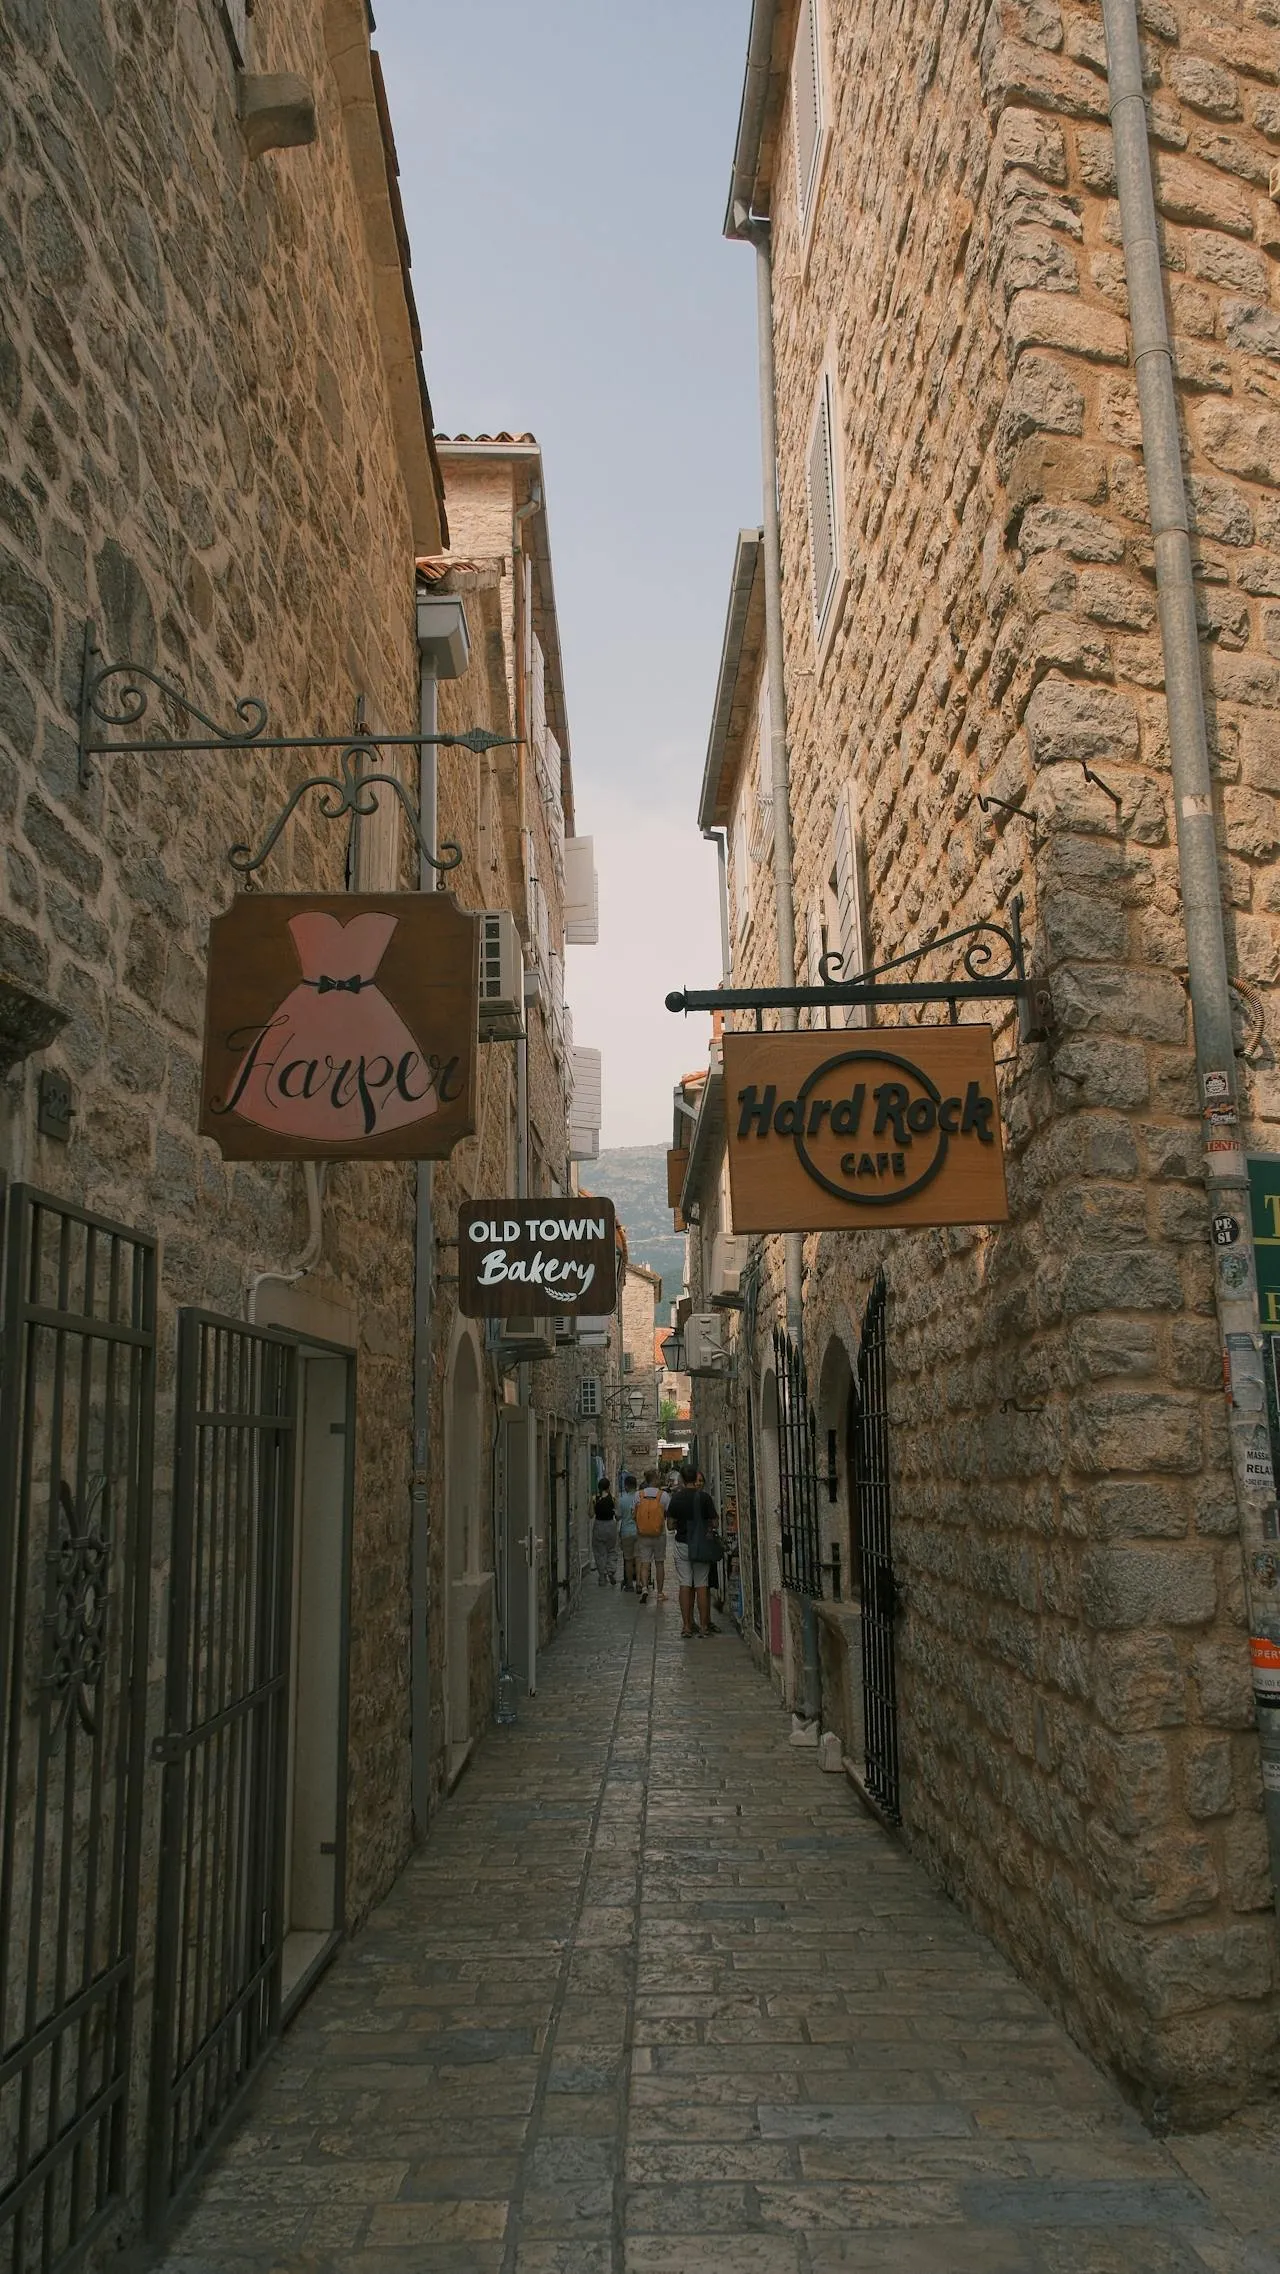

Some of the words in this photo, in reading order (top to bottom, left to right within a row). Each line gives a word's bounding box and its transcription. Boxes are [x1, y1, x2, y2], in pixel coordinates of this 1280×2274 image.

[209, 1014, 464, 1135] Harper
[737, 1083, 866, 1138] Hard
[873, 1081, 995, 1145] Rock
[840, 1152, 905, 1177] CAFE
[468, 1220, 521, 1243] OLD
[525, 1218, 605, 1242] TOWN
[1214, 1218, 1233, 1231] PE
[477, 1249, 595, 1296] Bakery
